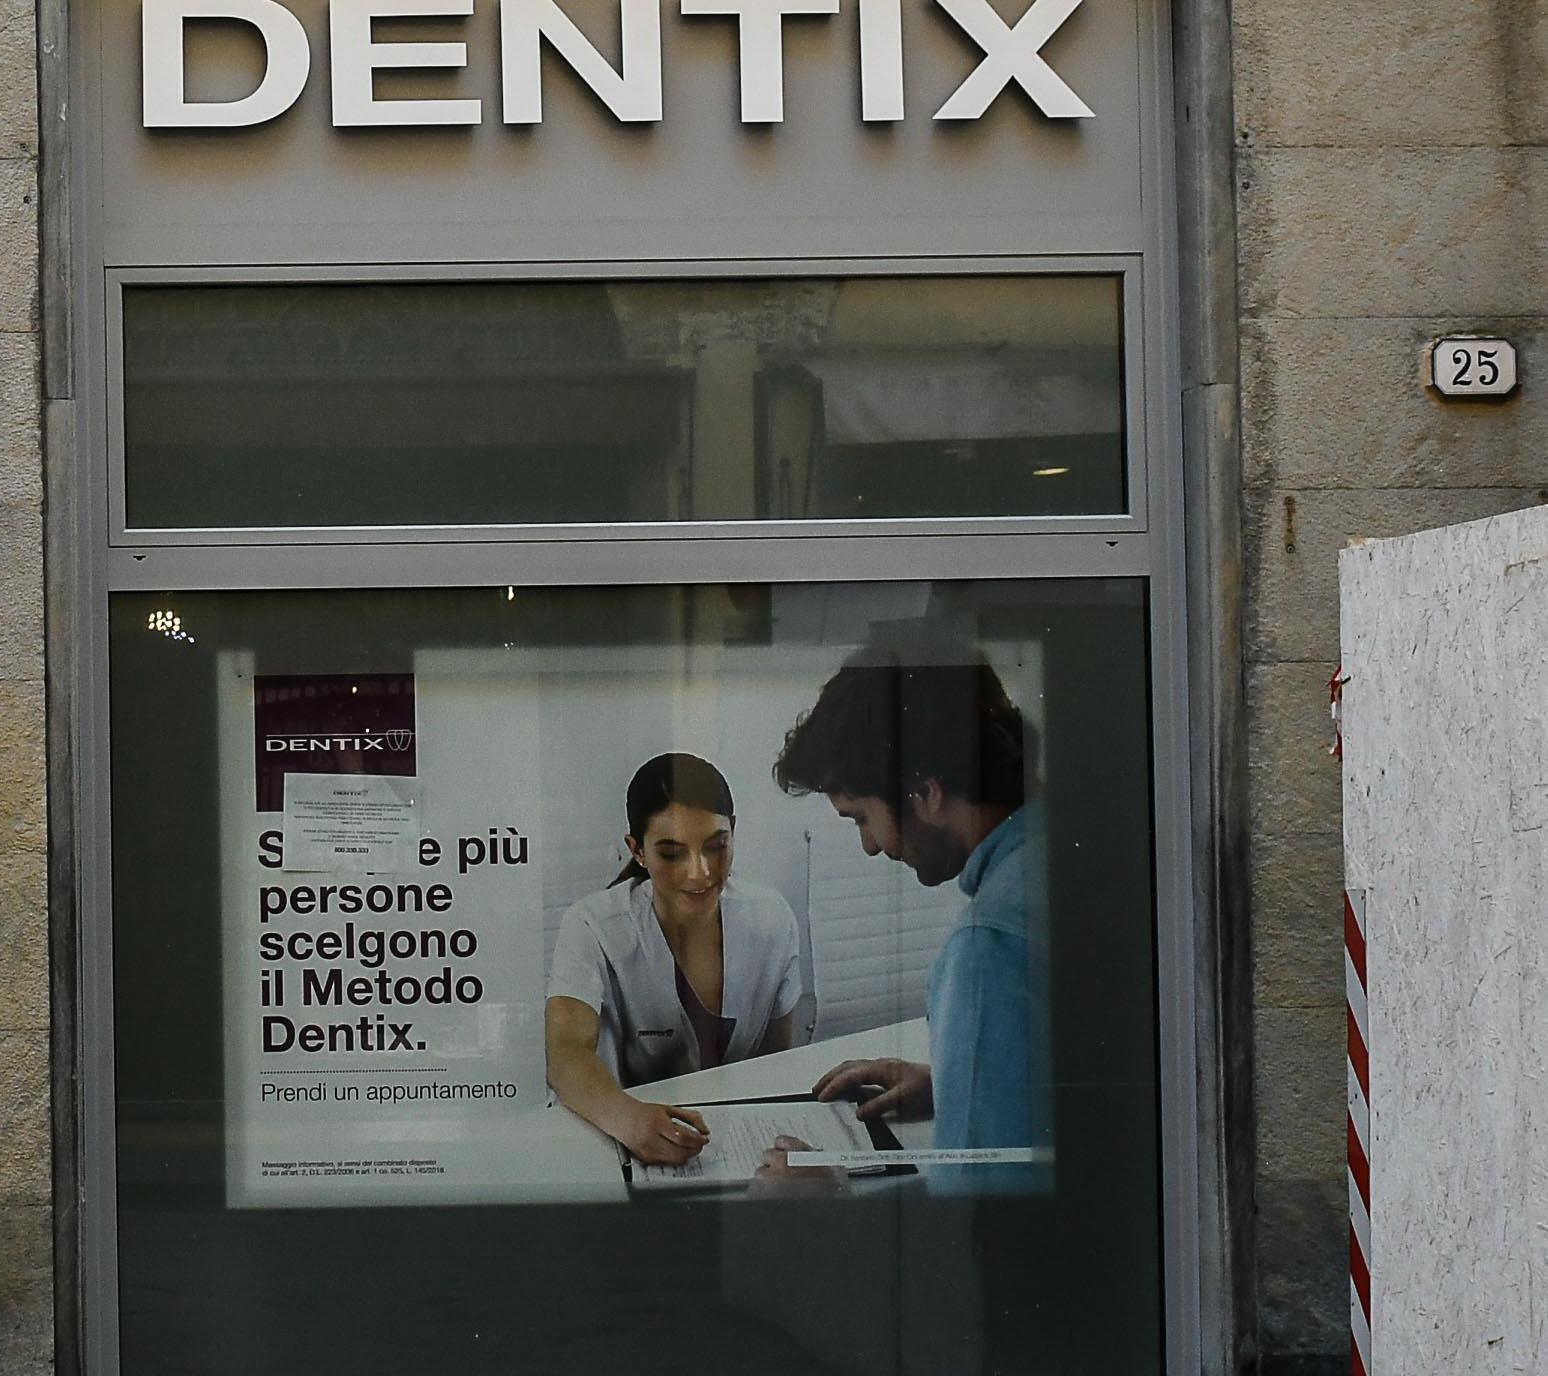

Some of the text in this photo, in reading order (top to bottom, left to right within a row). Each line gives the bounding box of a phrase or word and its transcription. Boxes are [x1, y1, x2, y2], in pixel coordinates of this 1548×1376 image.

[1452, 349, 1499, 385] 25
[266, 738, 384, 752] DENTIX
[458, 827, 529, 874] più
[259, 884, 453, 923] persone
[259, 923, 478, 968] scelgono
[261, 967, 483, 1006] il Metodo
[262, 1014, 426, 1052] Dentix.
[261, 1080, 517, 1104] Prendi un appuntamento
